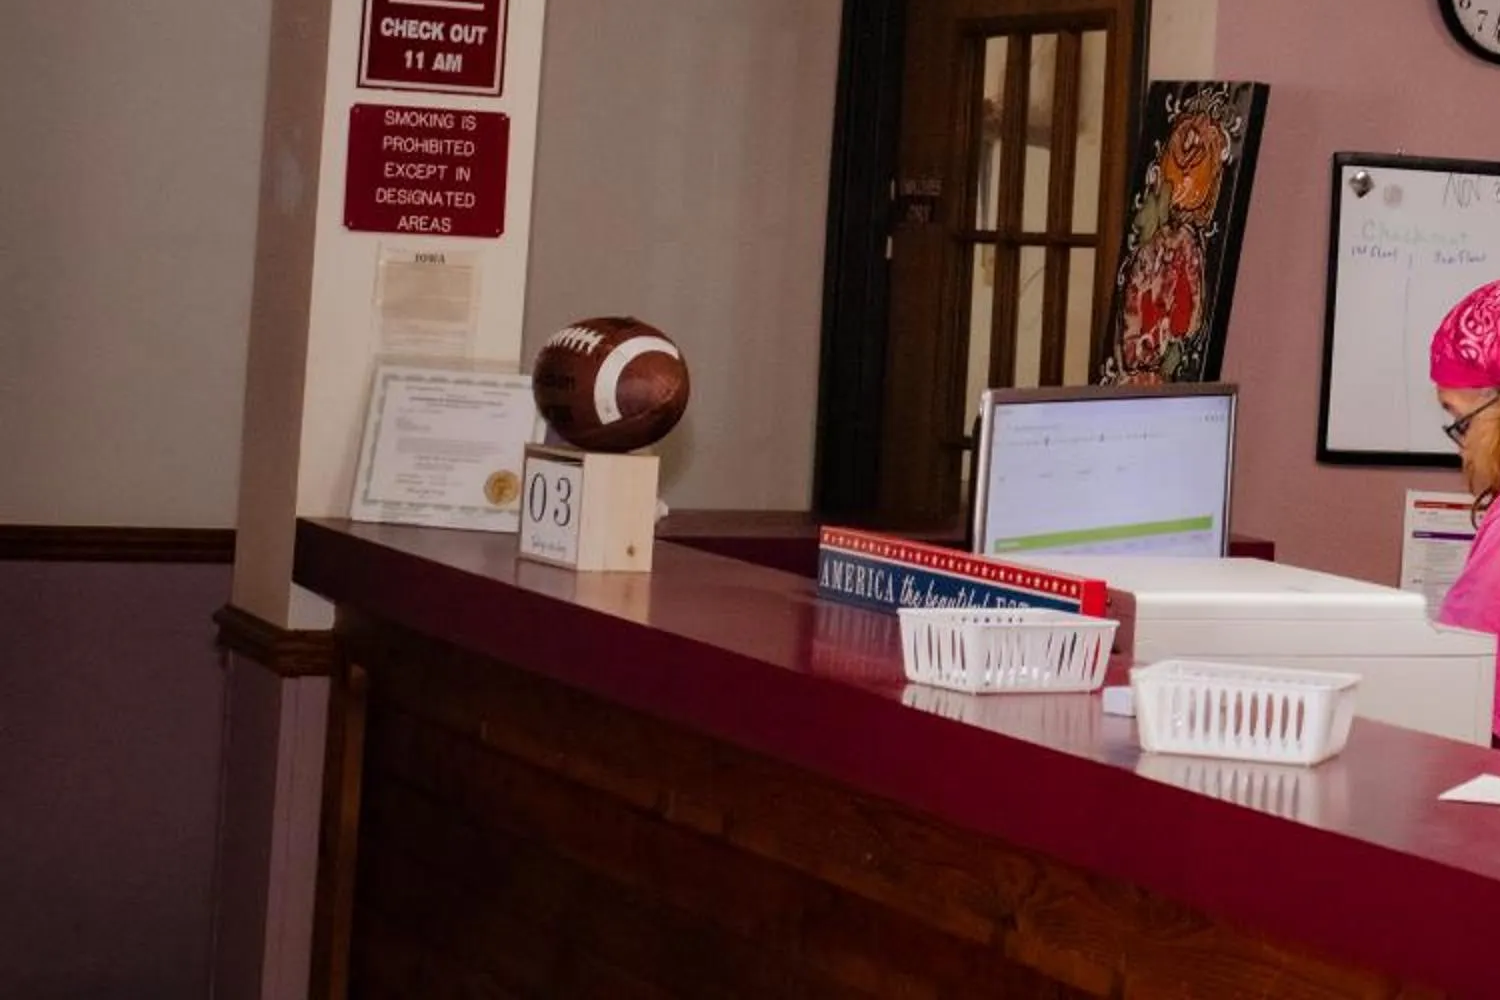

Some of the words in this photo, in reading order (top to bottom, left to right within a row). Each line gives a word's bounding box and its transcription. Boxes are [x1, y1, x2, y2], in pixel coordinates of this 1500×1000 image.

[380, 18, 444, 42] CHECK
[449, 23, 488, 46] OUT
[1477, 9, 1488, 32] 7
[403, 50, 425, 70] 11
[432, 52, 463, 73] AM
[384, 109, 455, 130] SMOKING
[461, 115, 477, 132] IS
[383, 136, 475, 157] PROHIBITED
[384, 162, 448, 180] EXCEPT
[455, 165, 471, 182] IN
[375, 187, 476, 208] DESIGNATED
[397, 215, 452, 234] AREAS
[529, 472, 572, 527] 03
[819, 559, 894, 602] AMERICA
[899, 574, 920, 609] the
